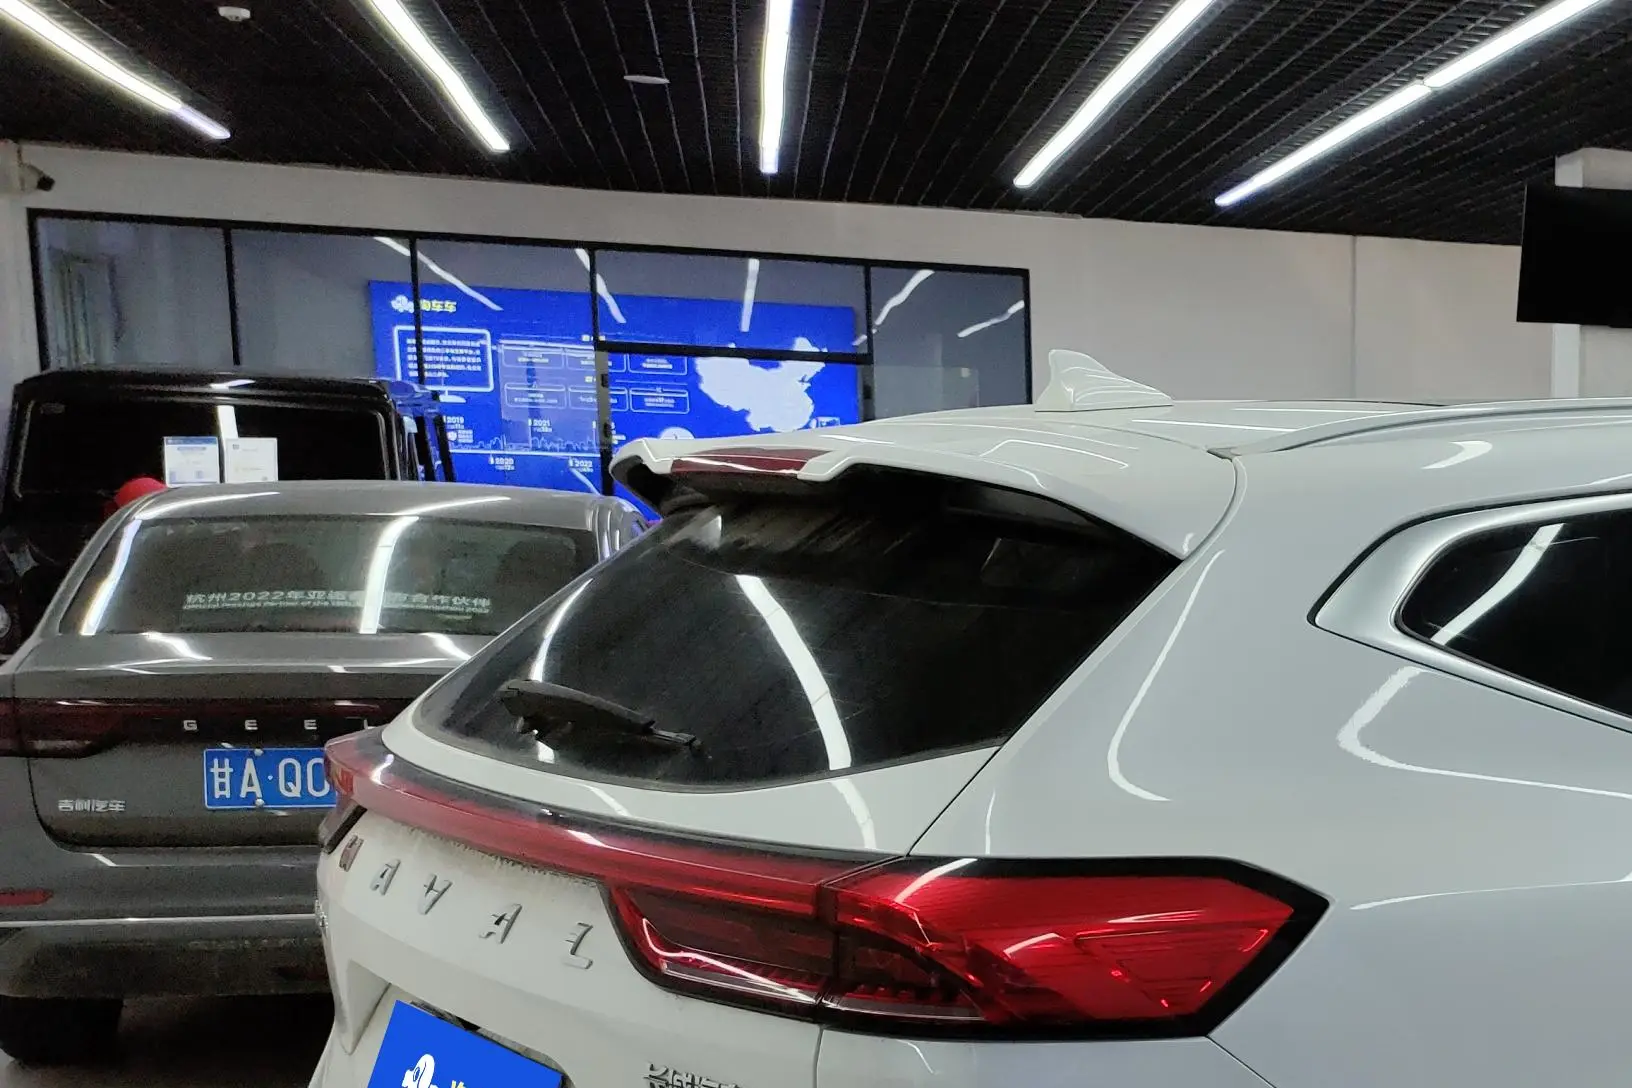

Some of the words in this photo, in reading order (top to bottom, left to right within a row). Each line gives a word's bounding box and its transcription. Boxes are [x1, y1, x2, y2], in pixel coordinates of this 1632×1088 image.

[58, 799, 126, 812] 吉利汽车
[338, 834, 594, 970] HAVAL
